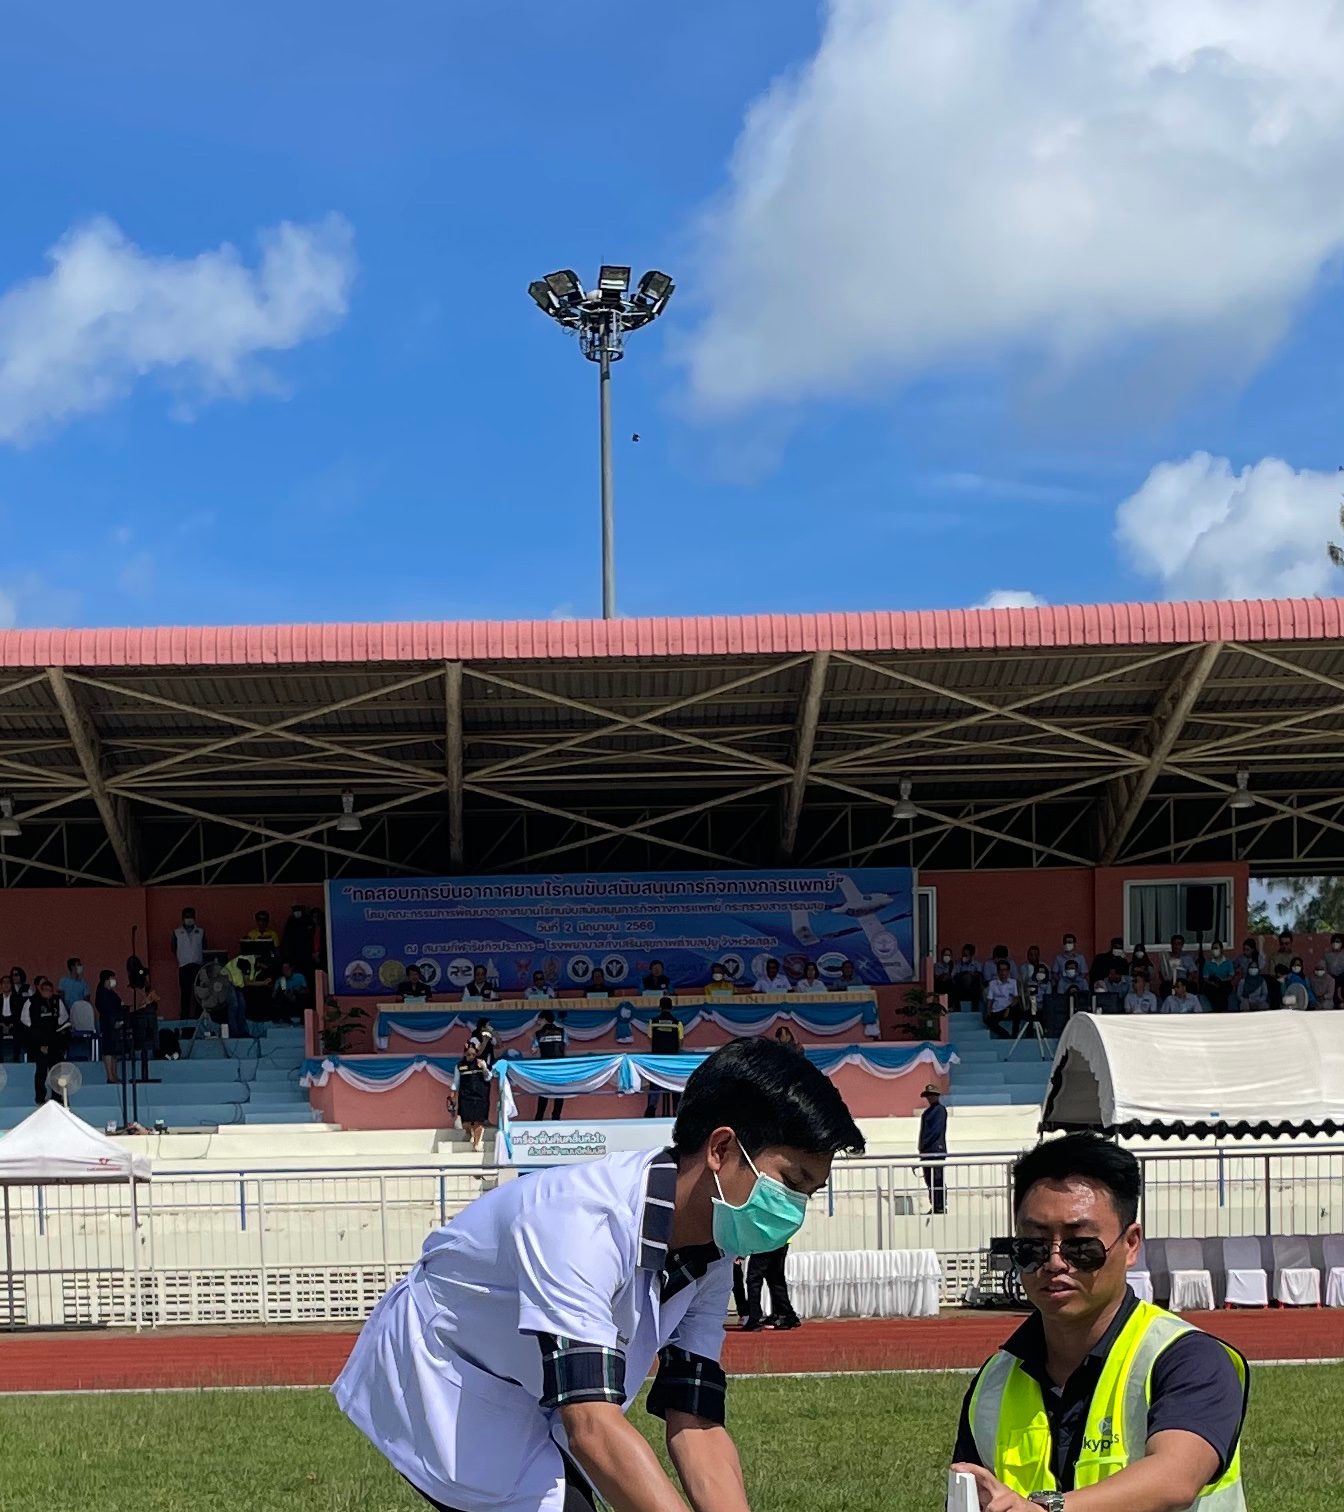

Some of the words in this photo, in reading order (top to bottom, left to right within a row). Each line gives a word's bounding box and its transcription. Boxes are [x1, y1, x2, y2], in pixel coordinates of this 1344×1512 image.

[537, 919, 559, 932] วันที่
[563, 922, 573, 932] 2
